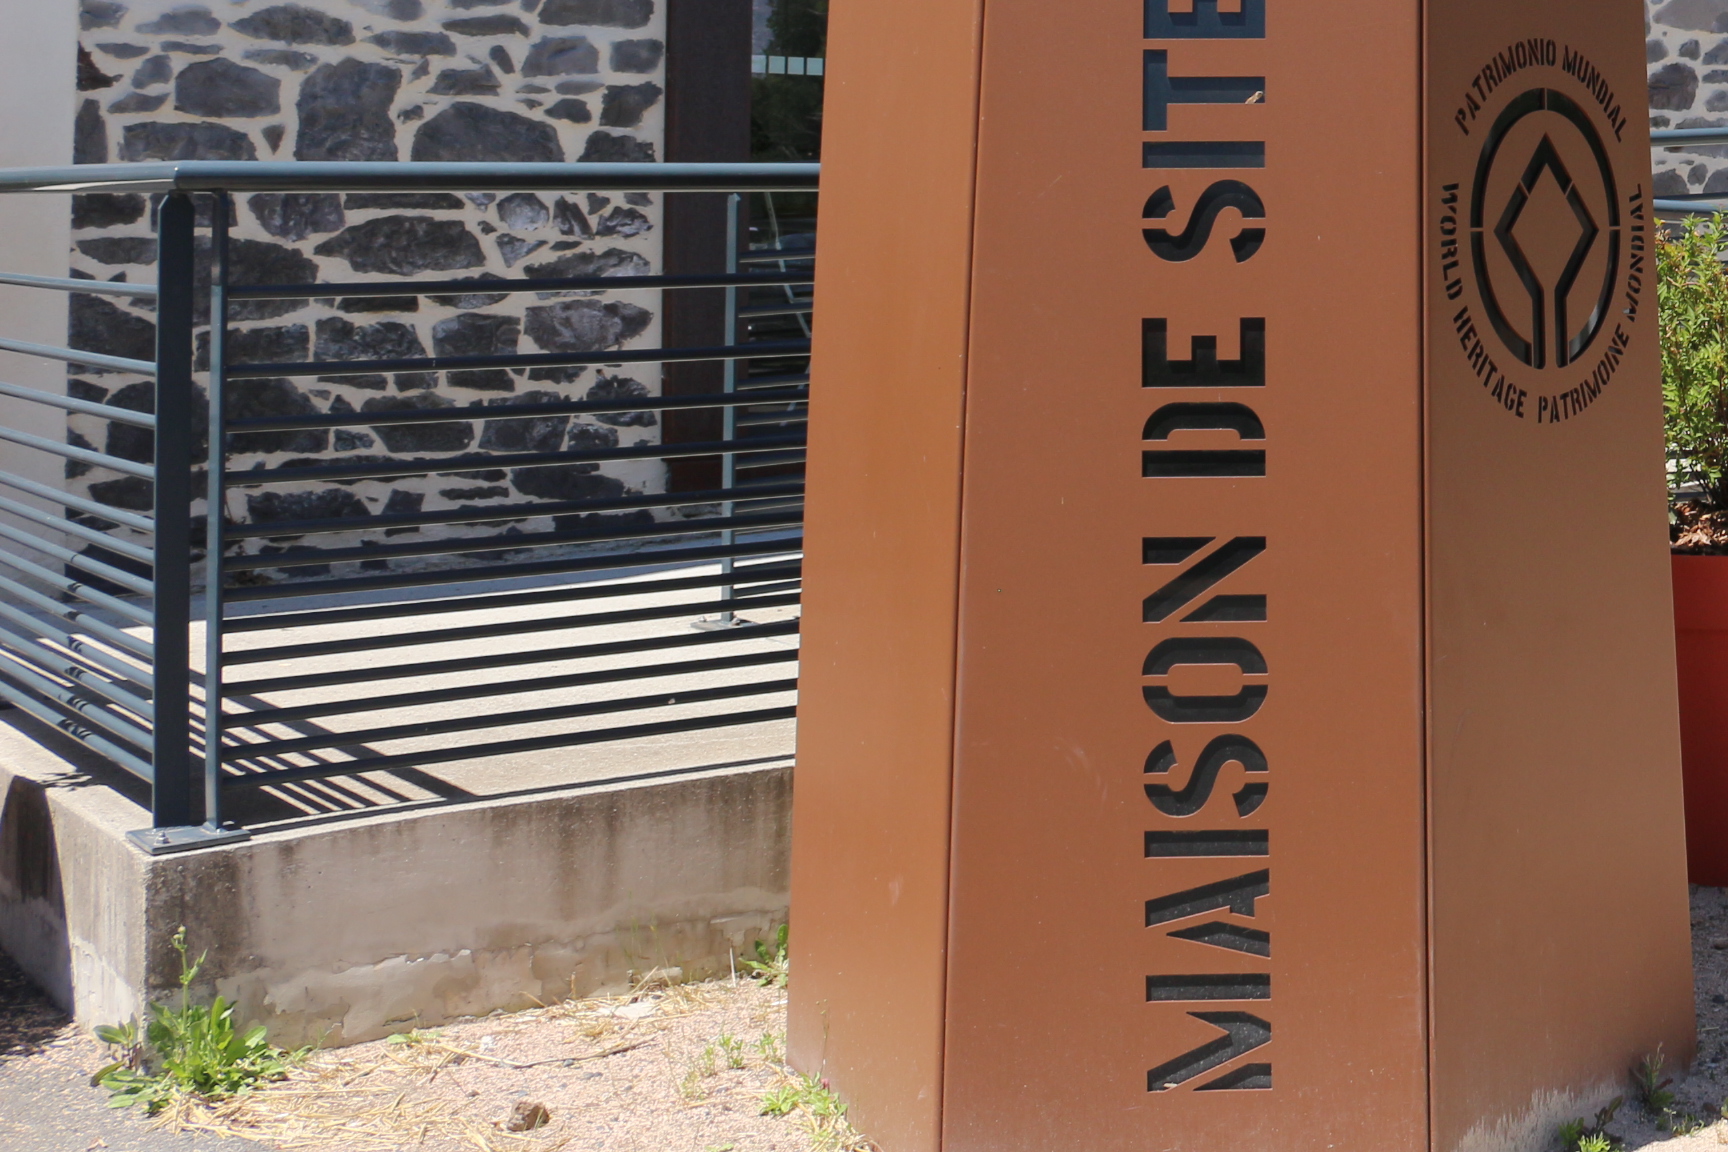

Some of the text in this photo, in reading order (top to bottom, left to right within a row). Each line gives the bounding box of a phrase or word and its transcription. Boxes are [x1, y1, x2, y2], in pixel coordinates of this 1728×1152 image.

[1454, 37, 1627, 144] PATRIMONIO MUNDIAL
[1141, 316, 1267, 478] DE
[1439, 182, 1528, 419] WORLD HERITAGE
[1537, 182, 1646, 425] PATRIMOINE MONDIAL
[1141, 534, 1273, 1093] MAISON
